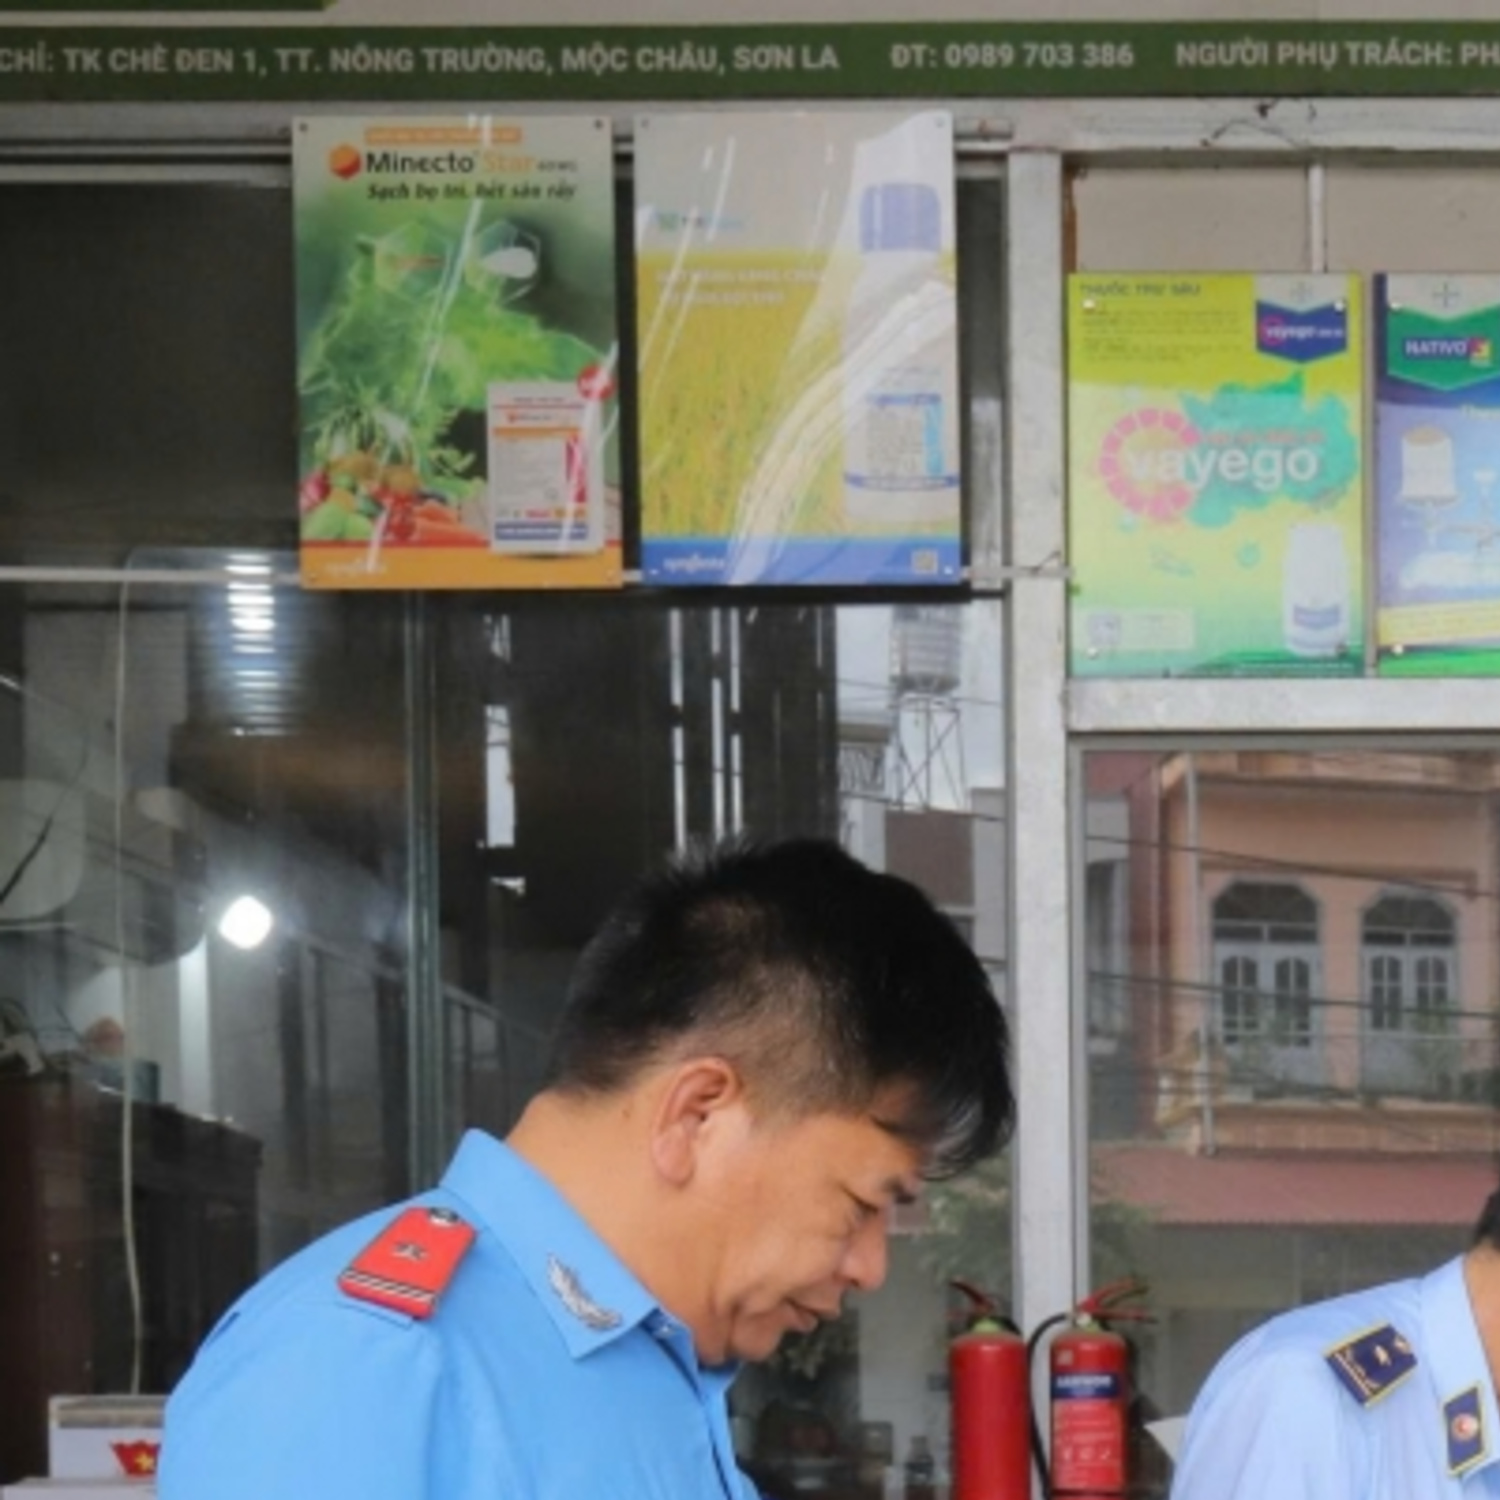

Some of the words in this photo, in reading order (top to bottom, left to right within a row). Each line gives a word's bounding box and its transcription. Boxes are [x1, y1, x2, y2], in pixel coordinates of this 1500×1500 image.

[62, 47, 101, 73] TK
[108, 41, 168, 73] CHÈ
[242, 47, 268, 77] 1,
[275, 47, 321, 73] TT.
[329, 41, 414, 73] NÔNG
[422, 42, 553, 76] TRƯỜNG,
[561, 42, 629, 75] MỘC
[635, 40, 725, 75] CHÂU,
[733, 43, 796, 70] SƠN
[802, 44, 840, 70] LA
[890, 43, 937, 69] ĐT:
[944, 43, 1013, 69] 0989
[1023, 43, 1075, 68] 703
[1082, 43, 1134, 68] 386
[1176, 36, 1269, 66] NGƯỜI
[1277, 40, 1336, 71] PHỤ
[1345, 37, 1453, 66] TRÁCH:
[366, 152, 475, 174] Minecto
[1405, 339, 1468, 357] NATIVO
[1126, 446, 1320, 492] vayego
